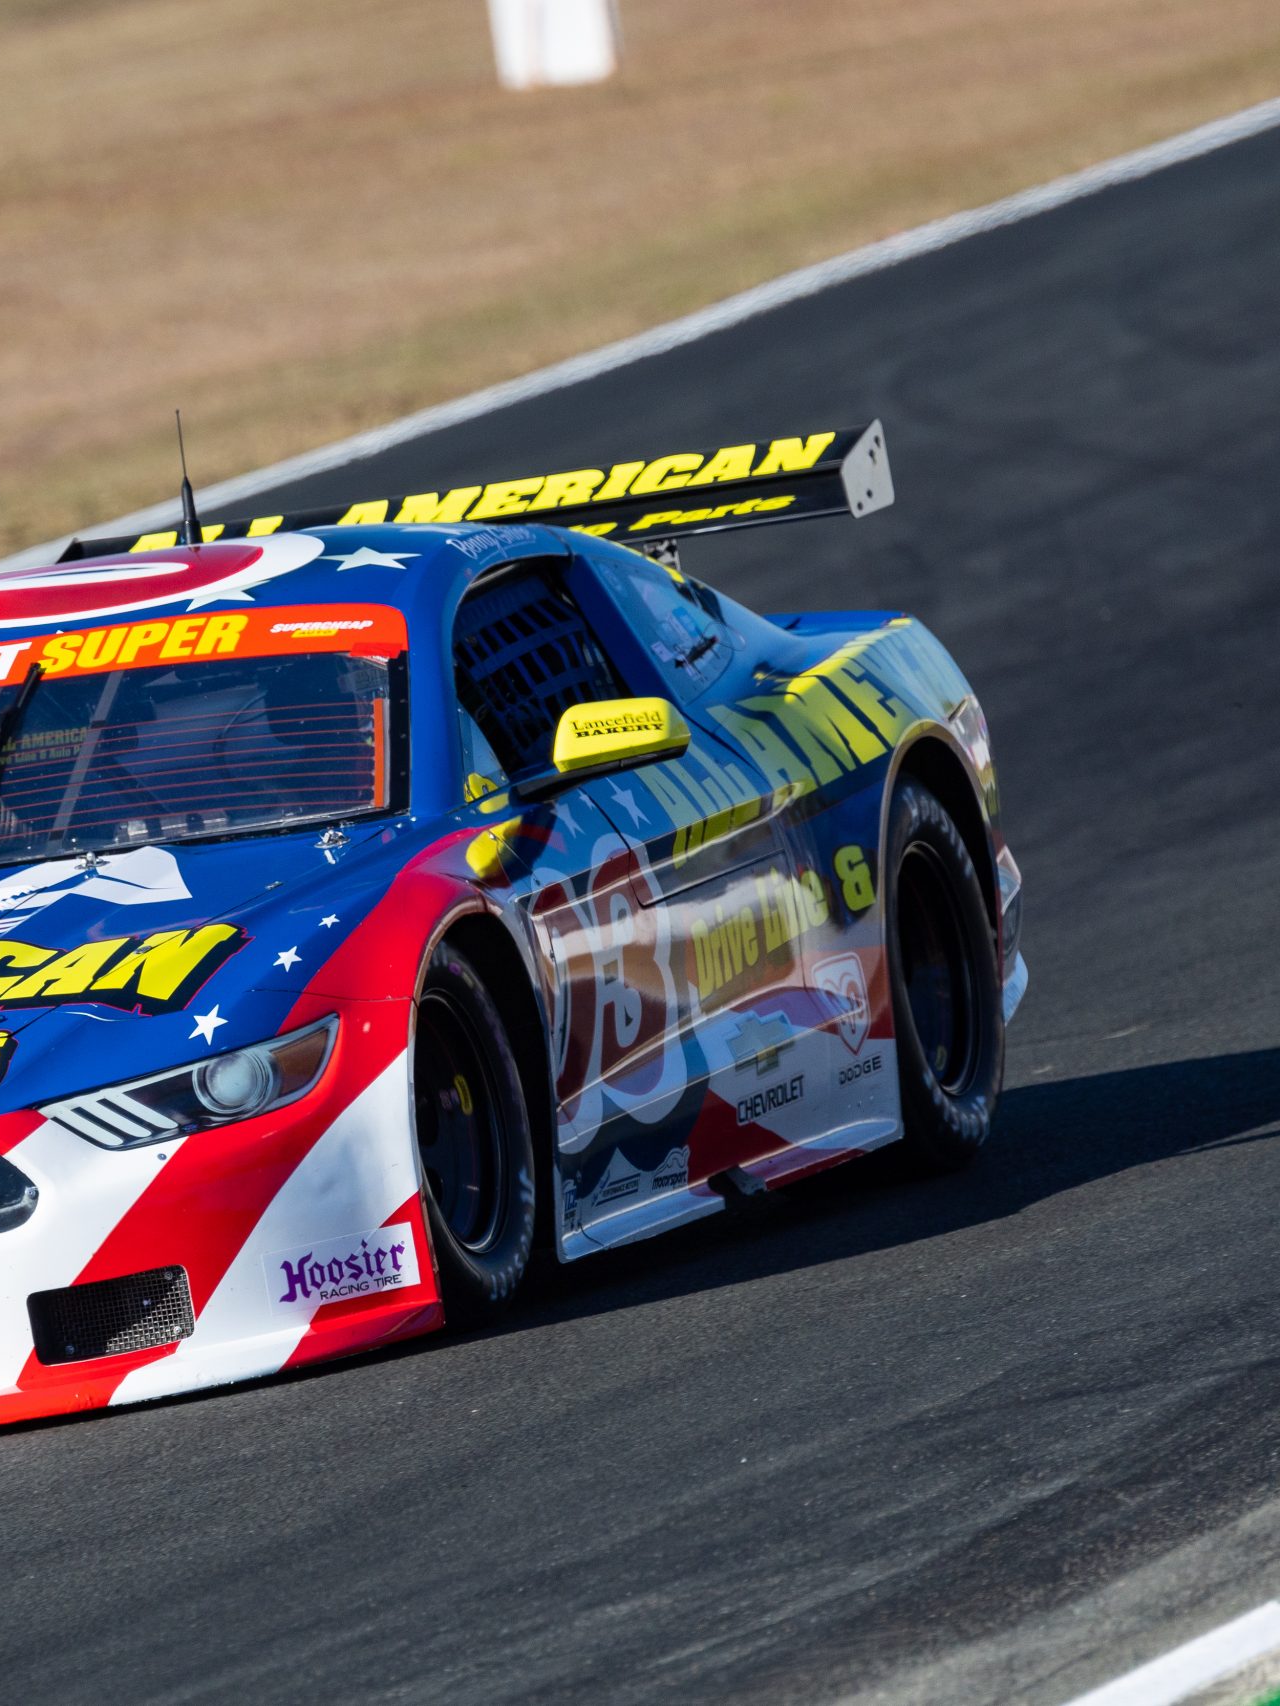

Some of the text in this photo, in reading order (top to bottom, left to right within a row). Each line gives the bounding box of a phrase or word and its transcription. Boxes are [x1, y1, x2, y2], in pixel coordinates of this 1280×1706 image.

[337, 430, 837, 527] AMERICAN
[628, 495, 795, 531] Parts
[270, 620, 374, 633] SUPERCHEAP
[39, 614, 249, 675] SUPER
[572, 711, 661, 731] Lancefield
[576, 723, 664, 737] BAKERY
[21, 727, 88, 748] AMERICA
[690, 844, 876, 1000] Drive Line &
[839, 1056, 881, 1085] DODGE
[737, 1075, 804, 1123] CHEVROLET
[279, 1239, 405, 1302] Hoosier
[320, 1273, 402, 1300] RACING TIRE
